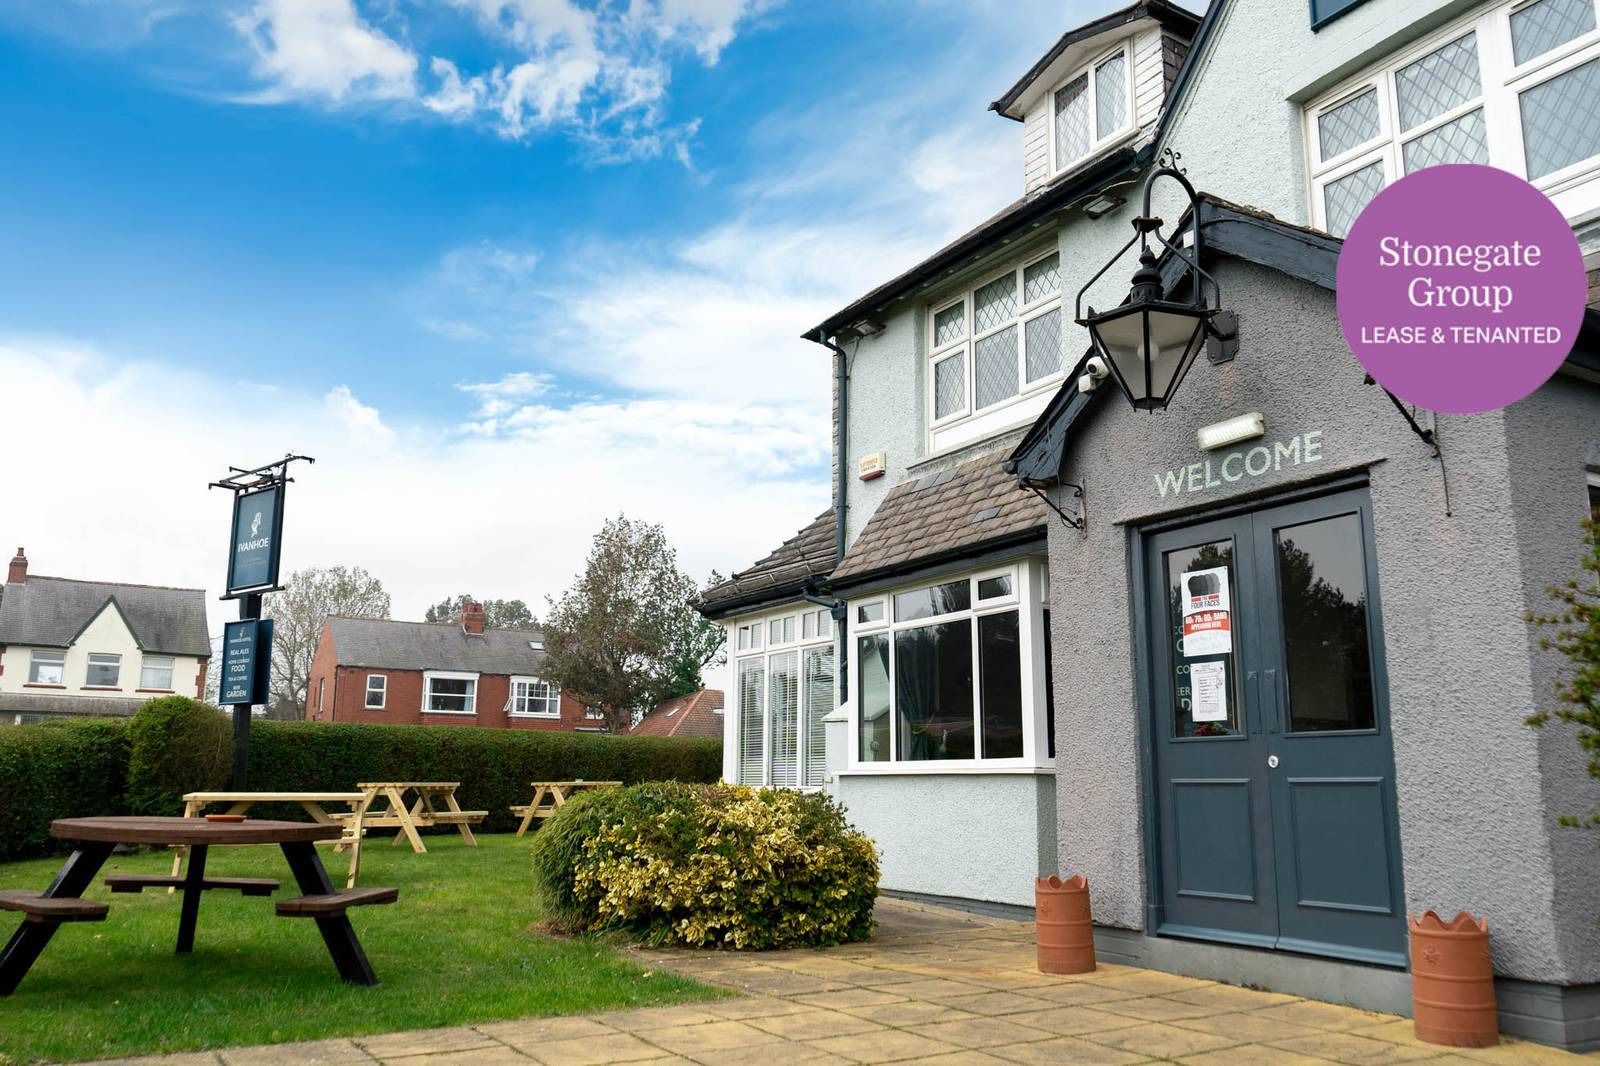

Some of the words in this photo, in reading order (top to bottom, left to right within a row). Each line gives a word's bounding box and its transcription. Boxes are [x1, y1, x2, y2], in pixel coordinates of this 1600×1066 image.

[1153, 430, 1323, 498] WELCOME
[238, 538, 269, 552] IVANHOE
[1191, 601, 1204, 609] FOUR
[1204, 600, 1220, 608] FACES
[231, 664, 246, 672] FOOD
[226, 690, 247, 698] GARDEN
